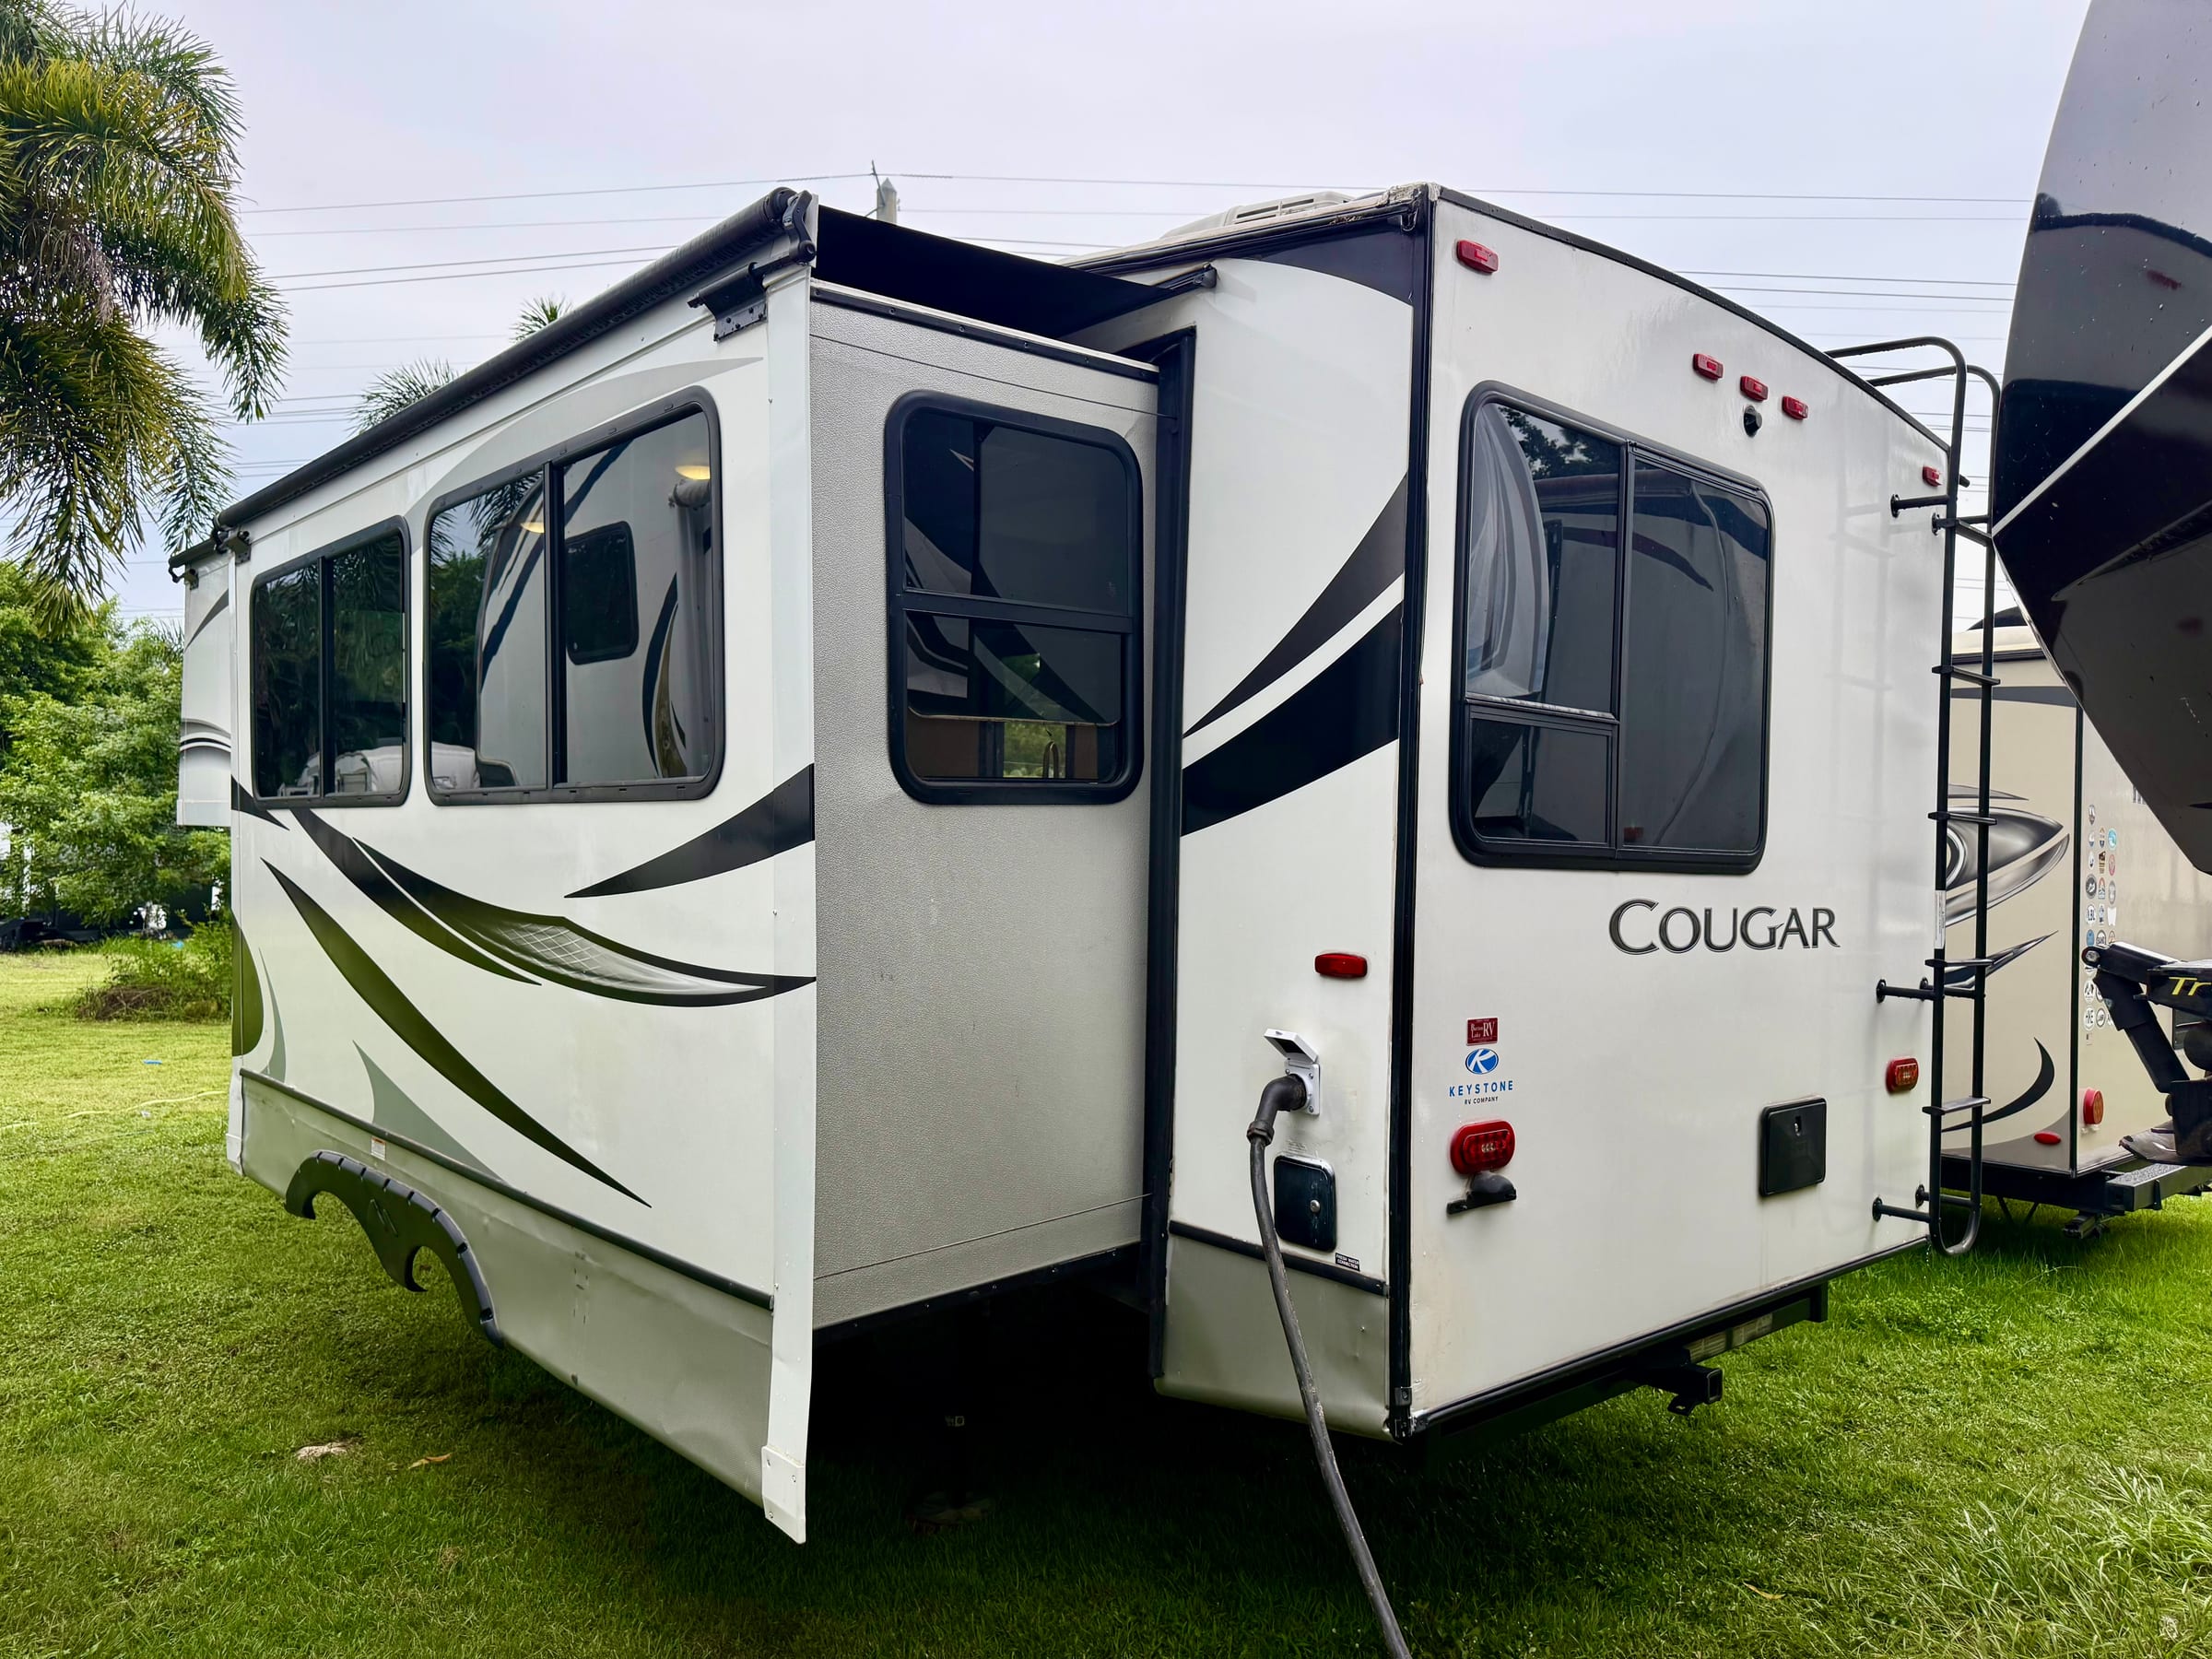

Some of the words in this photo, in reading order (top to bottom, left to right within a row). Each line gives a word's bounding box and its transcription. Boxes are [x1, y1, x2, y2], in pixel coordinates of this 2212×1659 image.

[1608, 898, 1841, 955] COUGAR
[1483, 1020, 1495, 1037] RV
[1449, 1080, 1513, 1097] KEYSTONE
[1473, 1096, 1499, 1104] COMPANY
